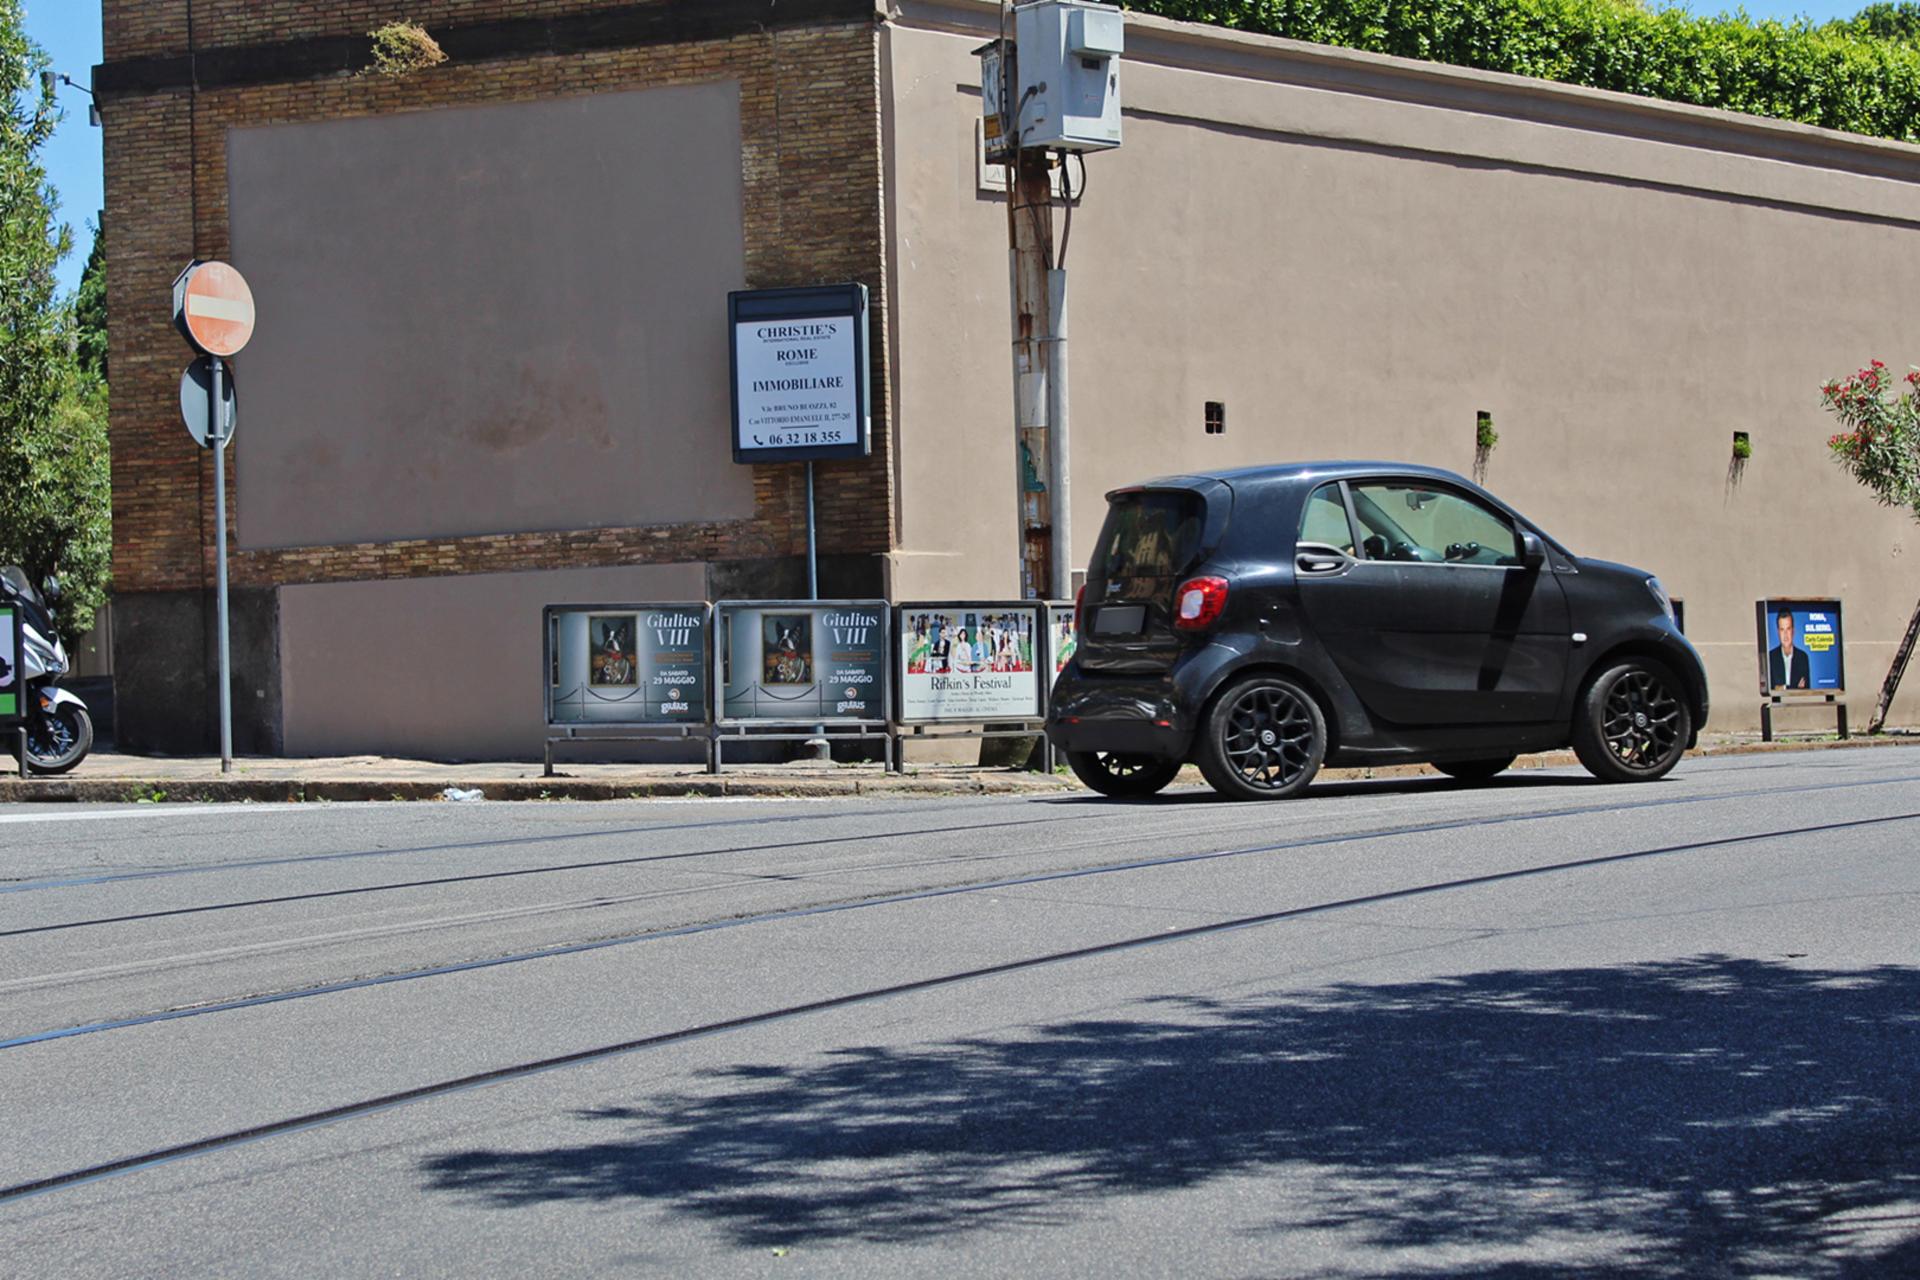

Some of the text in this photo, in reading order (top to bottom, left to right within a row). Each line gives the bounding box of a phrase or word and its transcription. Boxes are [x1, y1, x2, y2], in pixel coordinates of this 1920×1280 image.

[757, 323, 837, 339] CHRISTIE'S
[777, 348, 818, 361] ROME
[753, 376, 844, 392] IMMOBILIARE
[769, 431, 841, 445] 06 32 18 355
[647, 613, 700, 628] Giulius
[823, 612, 878, 627] Giulius
[657, 628, 690, 645] VIII
[833, 628, 867, 644] VIII
[653, 676, 696, 685] 29 MAGGIO
[829, 675, 873, 684] 29 MAGGIO
[931, 676, 1012, 691] Rifkin's Festival
